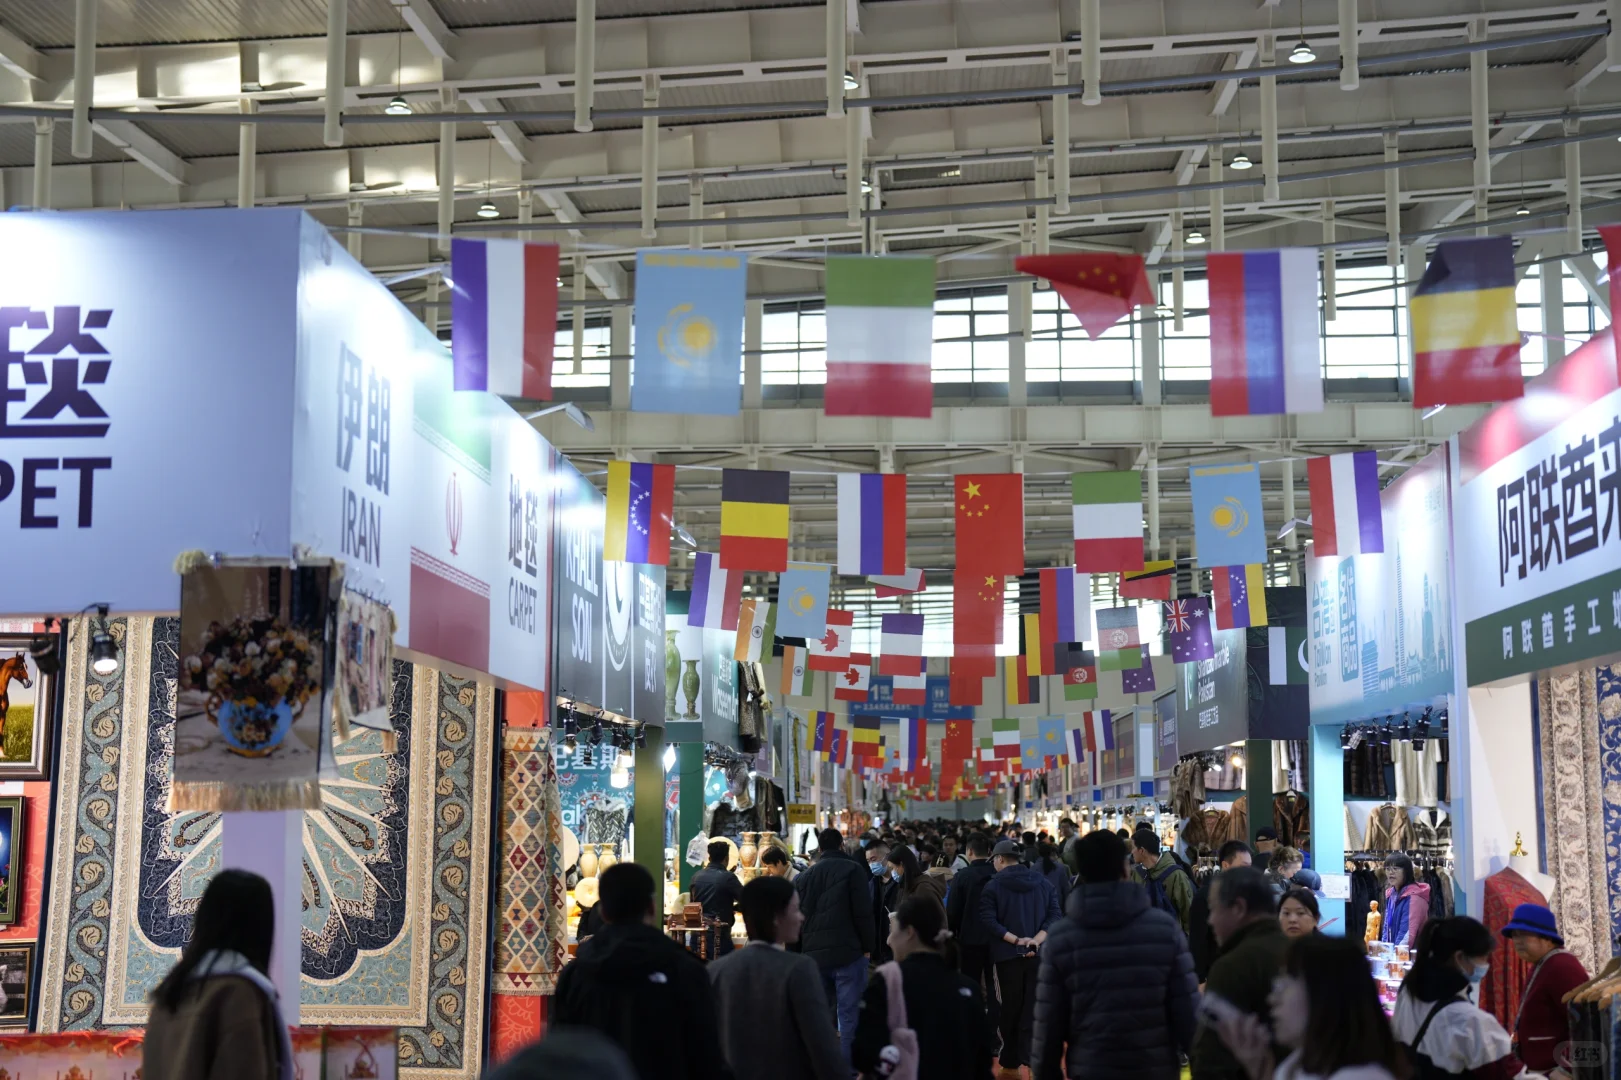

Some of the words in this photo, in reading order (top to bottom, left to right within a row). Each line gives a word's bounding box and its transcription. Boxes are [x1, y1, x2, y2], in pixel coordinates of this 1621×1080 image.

[335, 340, 391, 497] 伊朗
[340, 486, 382, 569] IRAN
[507, 473, 538, 579] 地毯
[508, 579, 538, 635] CARPET
[571, 592, 593, 664] SON
